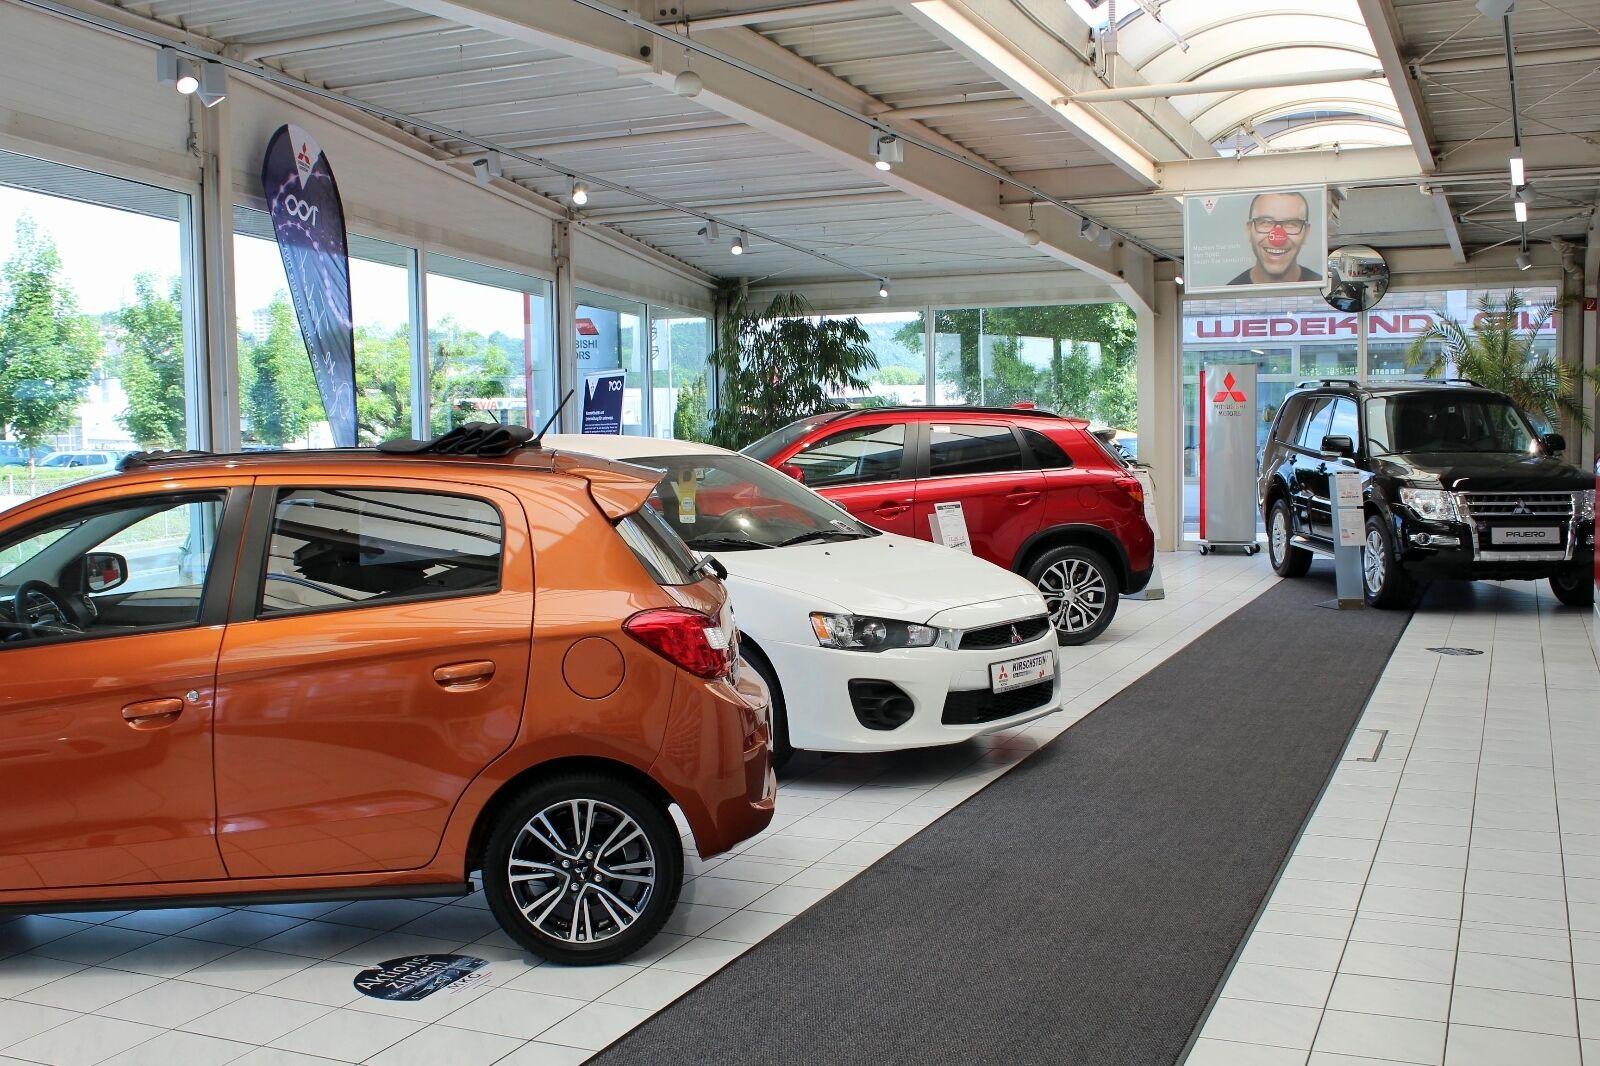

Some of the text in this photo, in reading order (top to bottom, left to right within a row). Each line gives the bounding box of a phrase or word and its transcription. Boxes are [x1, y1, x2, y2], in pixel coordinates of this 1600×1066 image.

[1196, 311, 1435, 339] WEDEKND
[1012, 655, 1046, 672] KIRSCHSTEIN
[356, 954, 431, 991] Aktions-
[385, 960, 449, 990] zinsen
